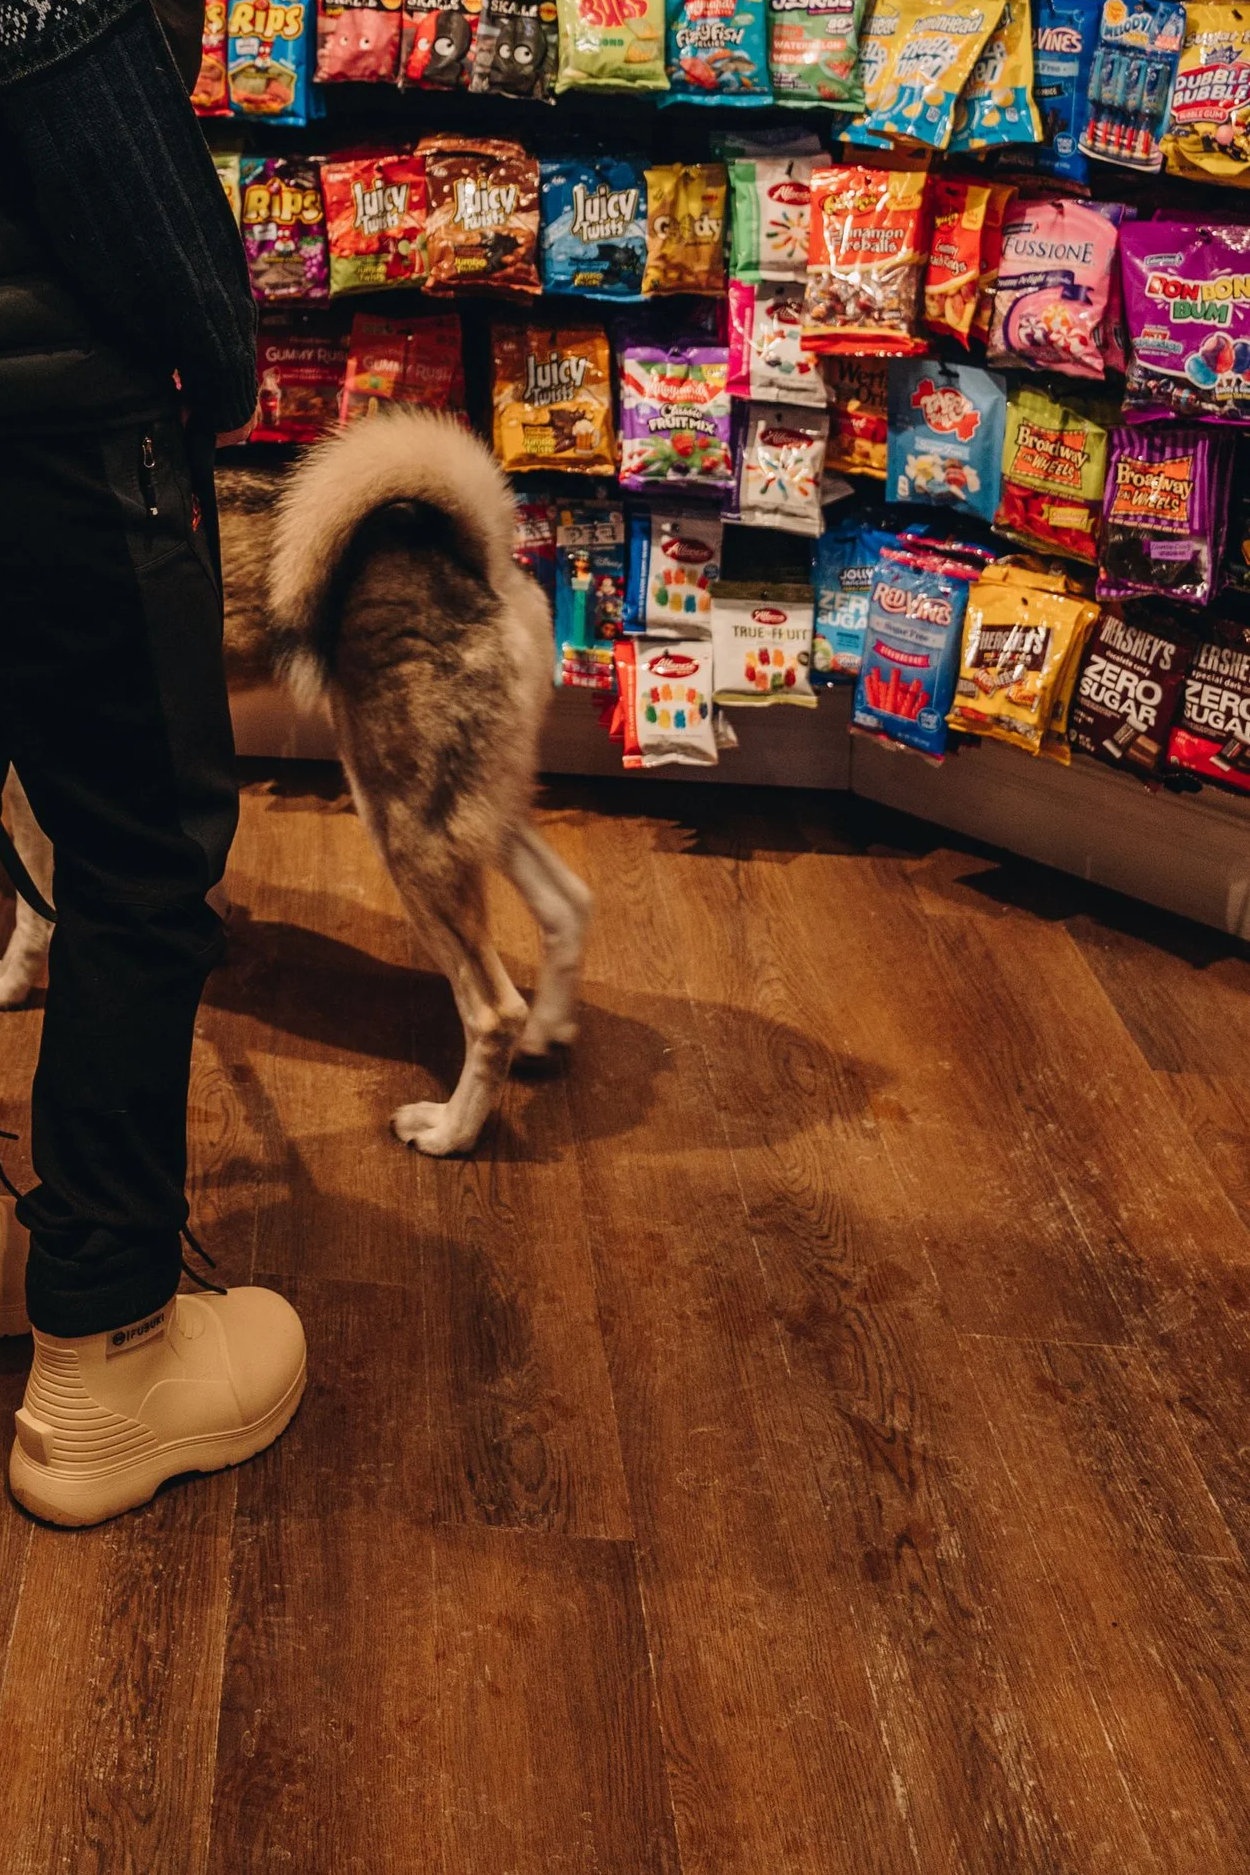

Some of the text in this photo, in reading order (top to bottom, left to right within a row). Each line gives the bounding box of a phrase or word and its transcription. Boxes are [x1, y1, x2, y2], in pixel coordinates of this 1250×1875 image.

[230, 2, 303, 38] Rips
[1173, 84, 1249, 103] BUBBLE
[1176, 68, 1249, 89] DUBBLE
[244, 181, 323, 224] Rips
[354, 181, 408, 215] Juicy
[455, 182, 515, 214] Juicy
[574, 187, 636, 222] Juicy
[362, 213, 398, 233] Twists
[465, 211, 505, 230] Twists
[581, 218, 625, 240] Twists
[1004, 236, 1095, 264] FUSSIONE
[1173, 302, 1229, 322] BUM
[266, 347, 313, 363] GUMMY
[526, 355, 586, 393] Juicy
[532, 385, 574, 404] Twists
[648, 416, 714, 434] FRUIT MIX
[1017, 424, 1089, 467] Broadway
[1116, 463, 1193, 500] Broadway
[1100, 615, 1177, 670] HERSHEY'S
[1088, 655, 1163, 707] ZERO
[1080, 677, 1157, 726] SUGAR
